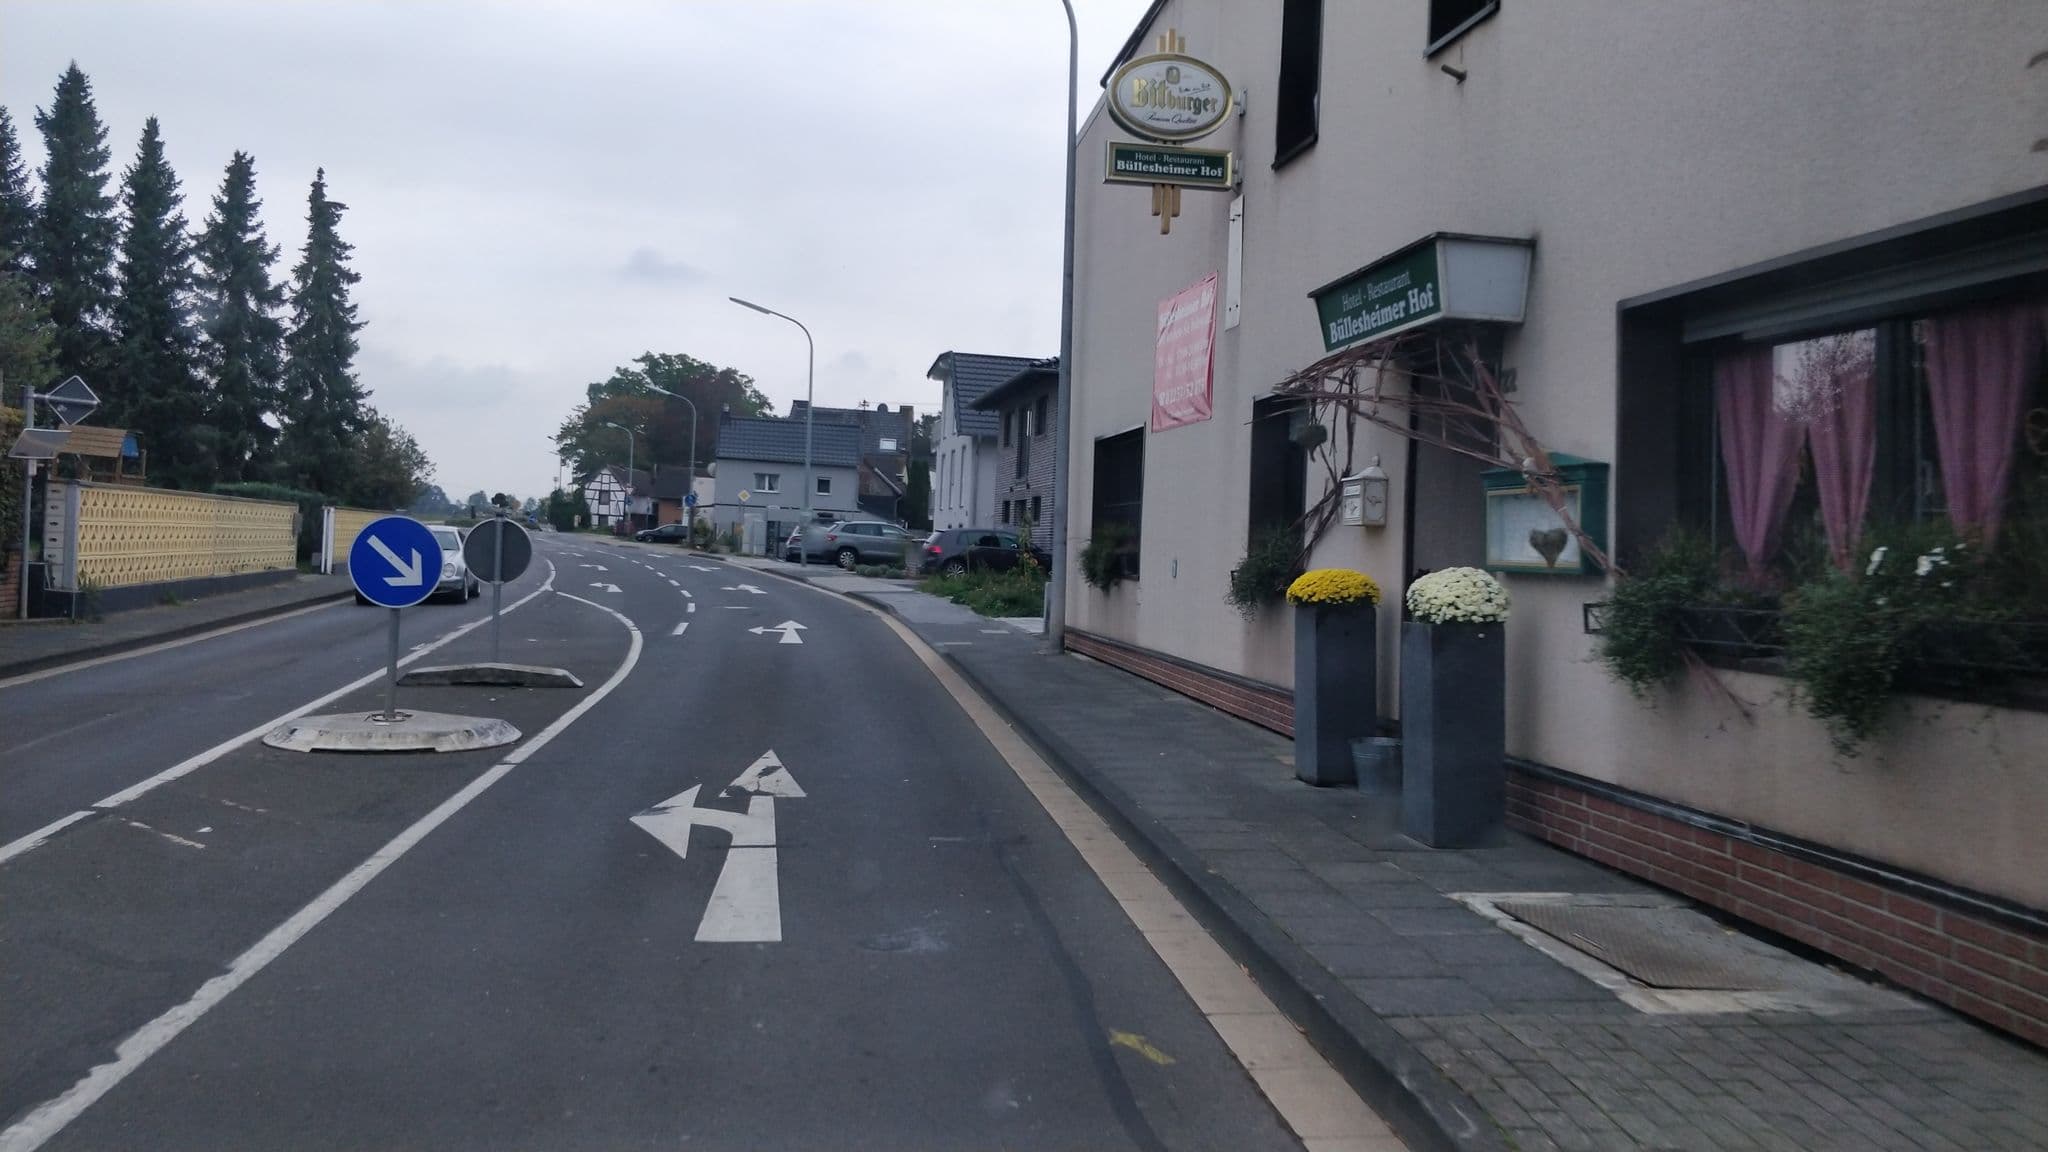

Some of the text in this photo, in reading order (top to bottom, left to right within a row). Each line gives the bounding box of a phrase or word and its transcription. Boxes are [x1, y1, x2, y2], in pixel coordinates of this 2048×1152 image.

[1131, 78, 1218, 114] Bitburger
[1116, 160, 1223, 177] Büllesheimer Hof
[1135, 152, 1156, 162] Hotel
[1163, 154, 1205, 165] Restaurant
[1342, 288, 1362, 312] Hotel
[1367, 271, 1411, 300] Restaurant
[1329, 282, 1435, 344] Büllesheimer Hof
